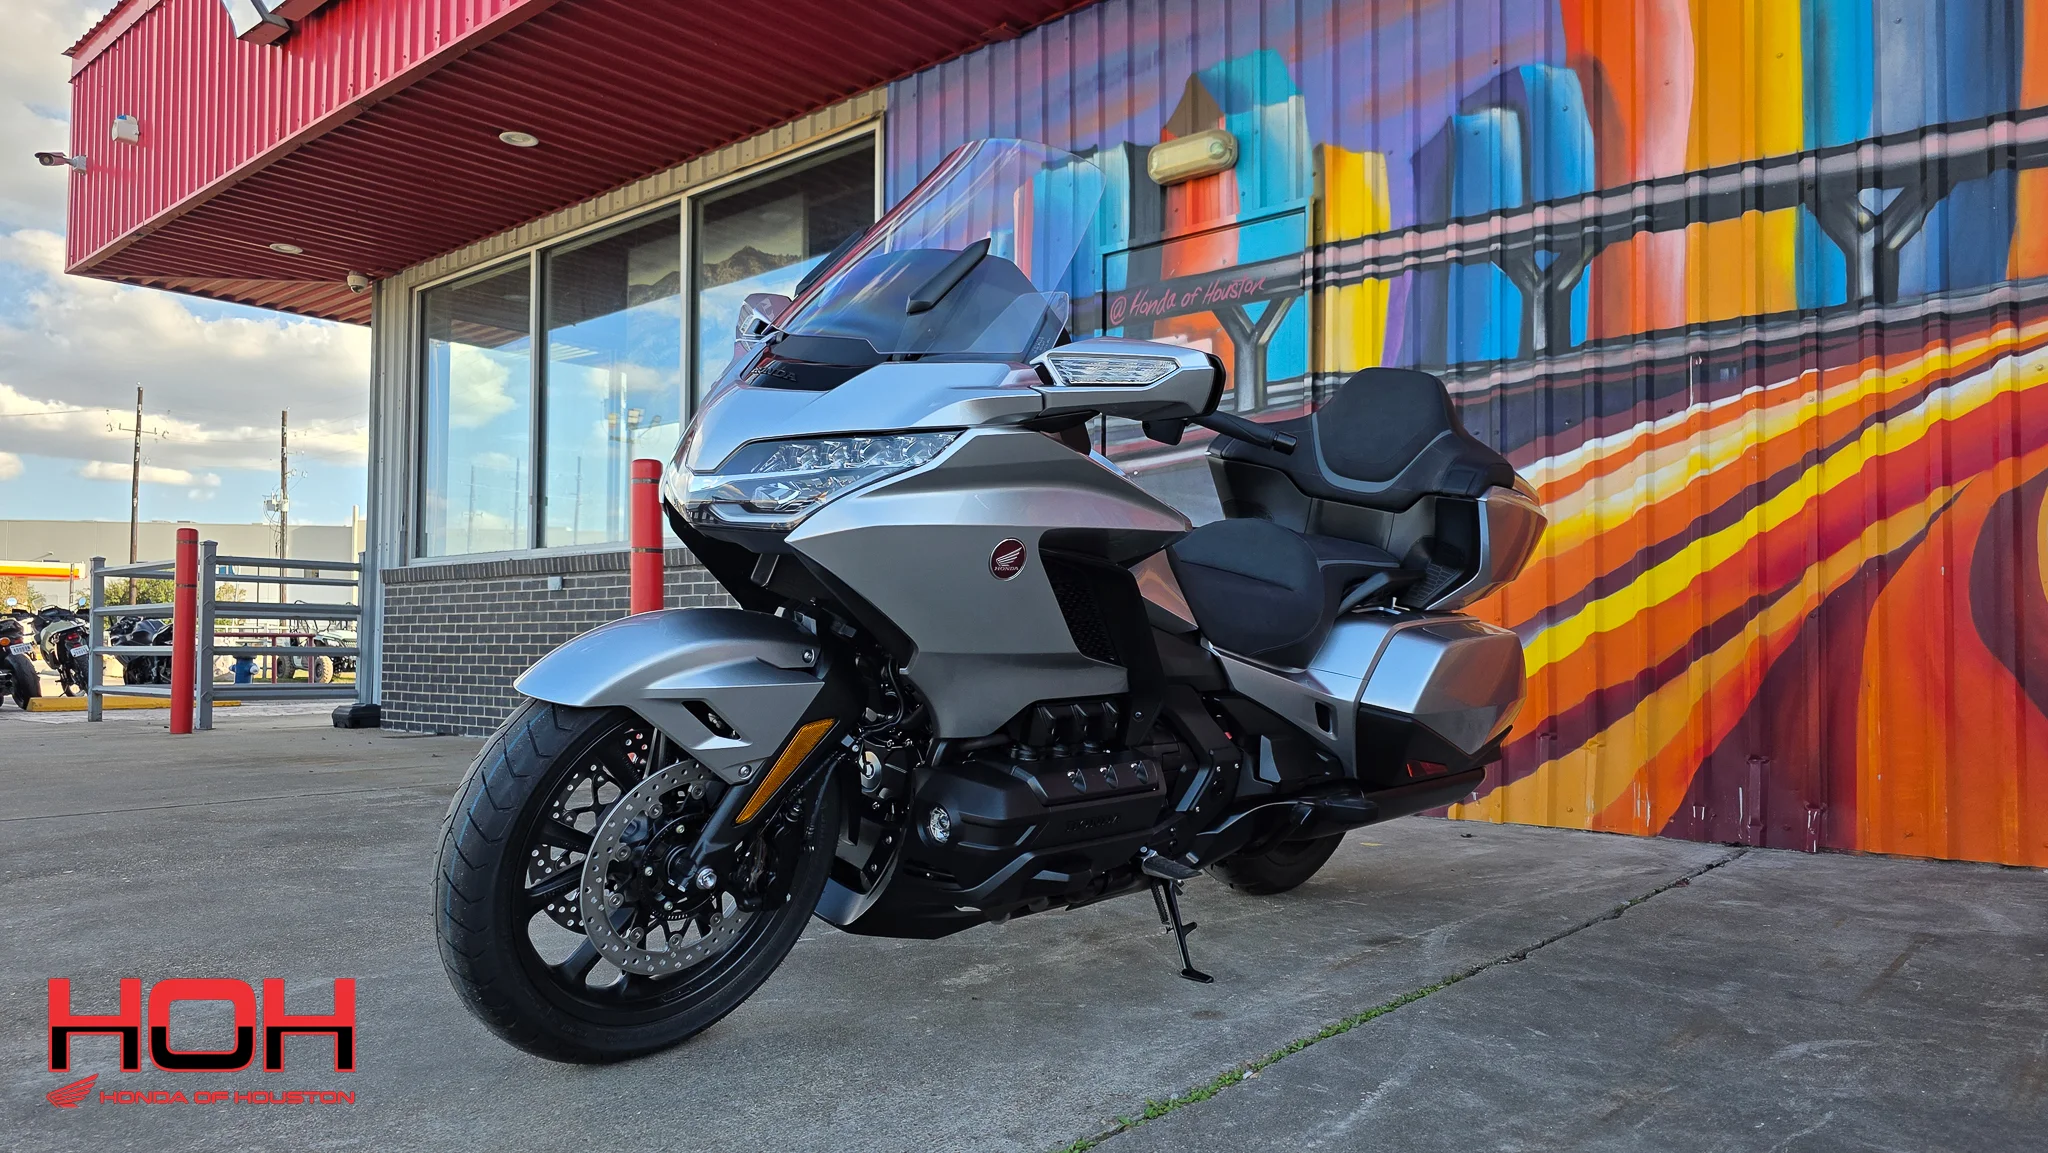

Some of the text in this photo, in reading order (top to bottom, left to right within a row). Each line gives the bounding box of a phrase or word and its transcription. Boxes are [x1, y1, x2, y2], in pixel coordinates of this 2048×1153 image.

[1110, 274, 1266, 325] @ Honda of Houston
